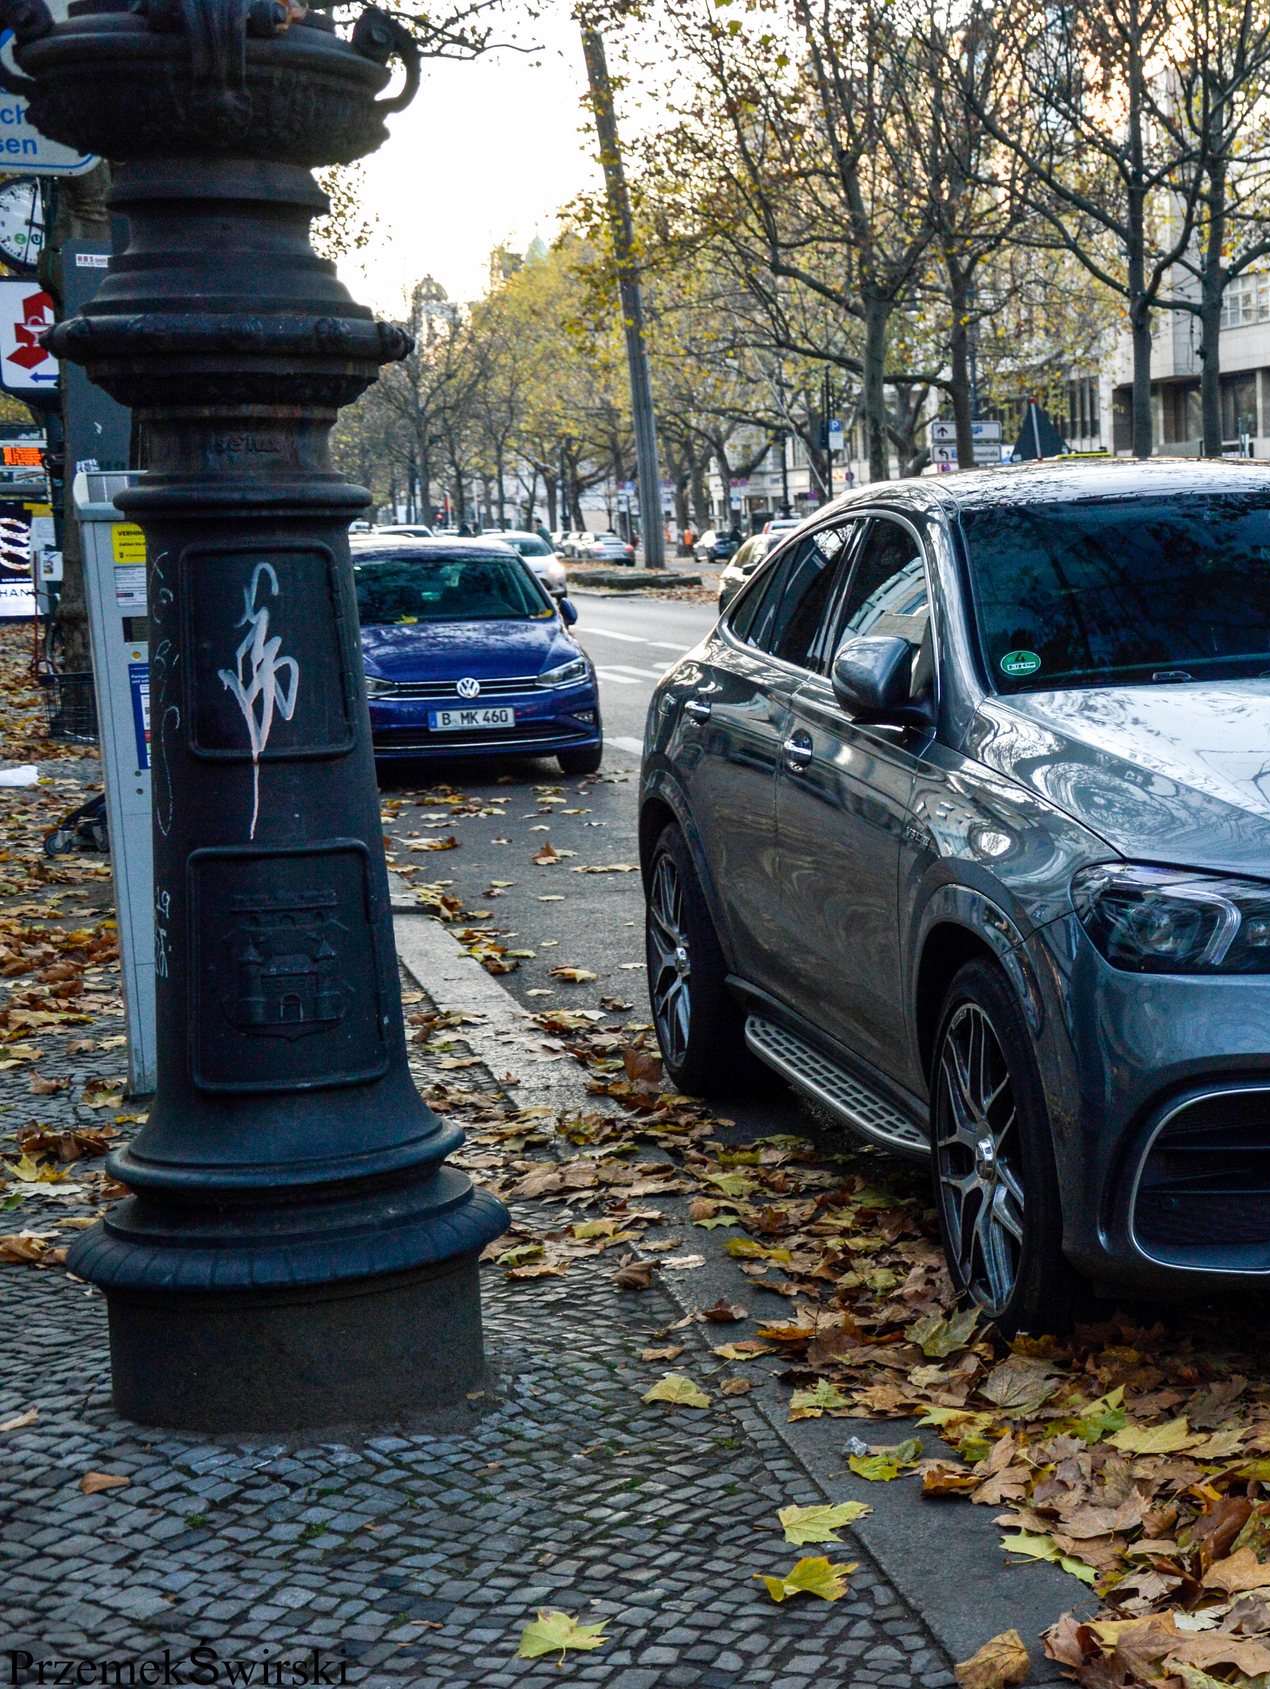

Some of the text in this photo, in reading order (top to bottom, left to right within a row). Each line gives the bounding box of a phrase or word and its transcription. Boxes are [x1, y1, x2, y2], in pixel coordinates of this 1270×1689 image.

[1014, 652, 1026, 662] 4
[442, 713, 451, 726] B
[460, 711, 479, 725] MK
[483, 709, 509, 724] 460
